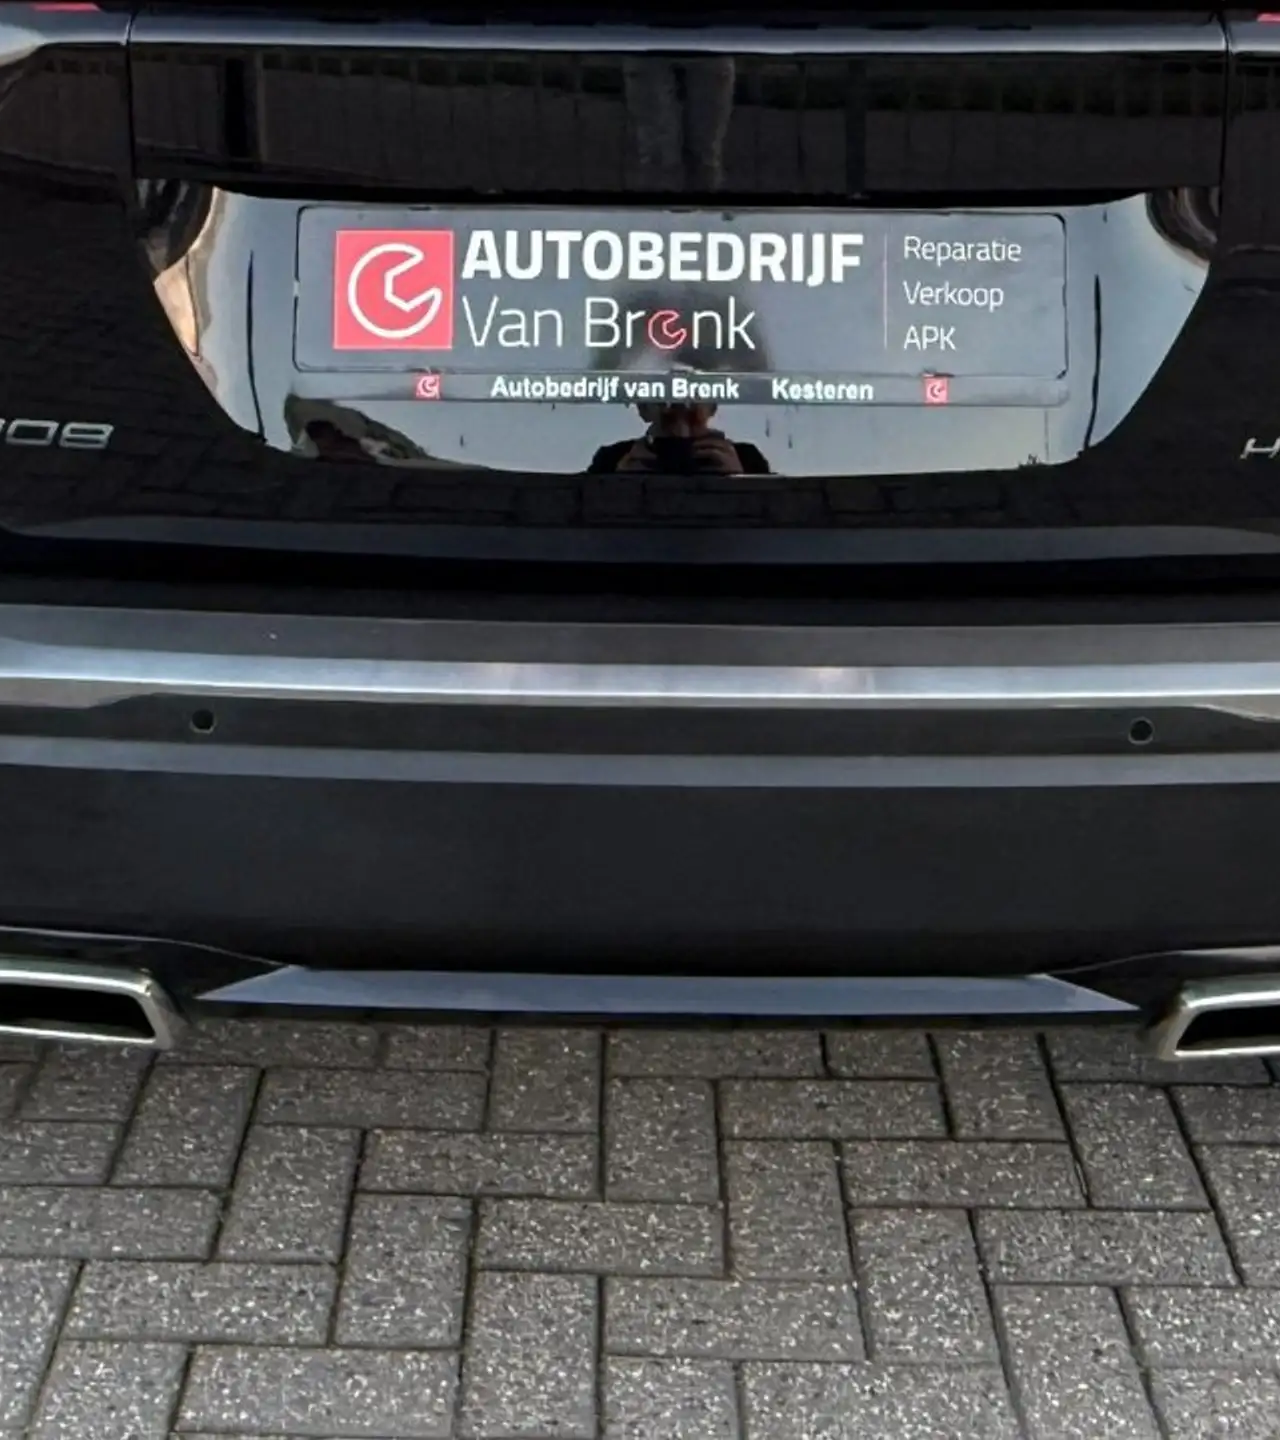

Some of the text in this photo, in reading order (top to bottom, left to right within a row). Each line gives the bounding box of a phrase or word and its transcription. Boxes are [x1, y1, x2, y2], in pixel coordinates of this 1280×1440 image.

[461, 229, 864, 287] AUTOBEDRIJF
[903, 235, 1021, 266] Reparatie
[902, 280, 1004, 312] Verkoop
[461, 294, 563, 350] Van
[903, 325, 956, 350] APK
[490, 375, 620, 403] Autobedrijf
[624, 381, 666, 398] van
[771, 378, 874, 401] Kesteren
